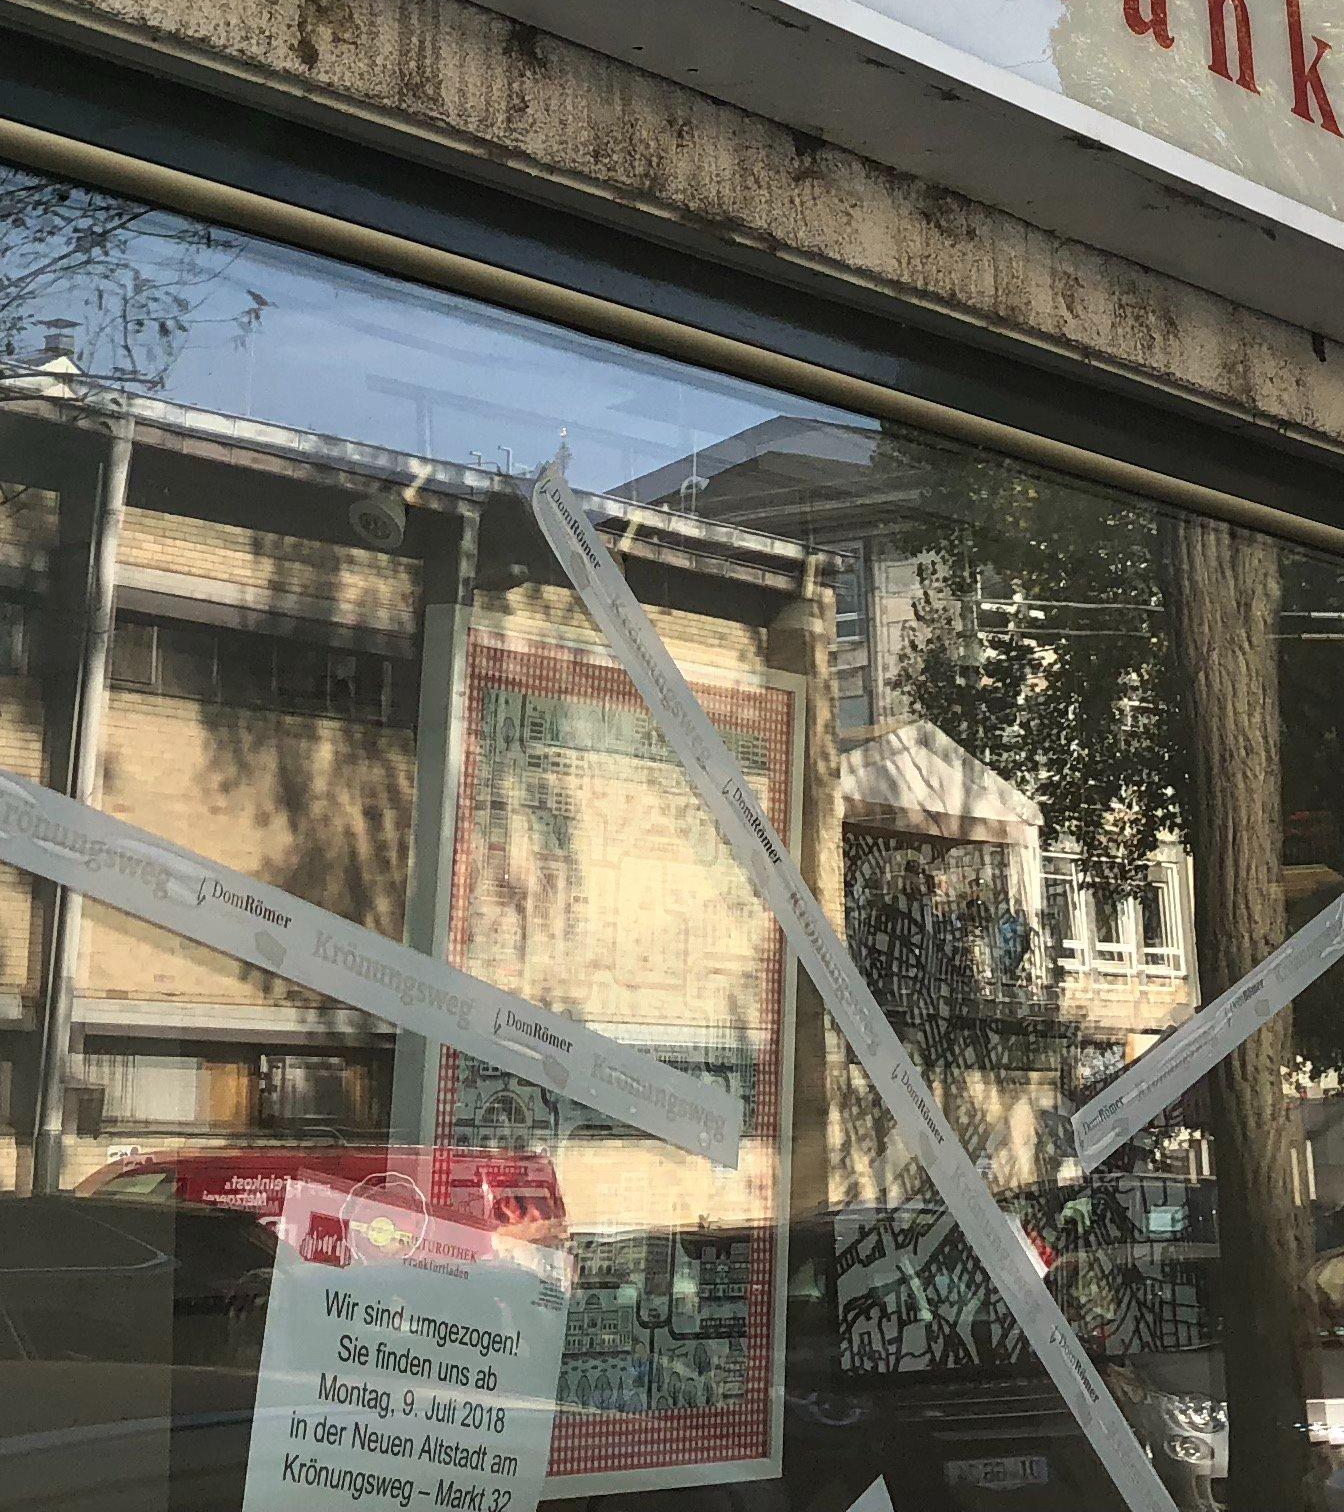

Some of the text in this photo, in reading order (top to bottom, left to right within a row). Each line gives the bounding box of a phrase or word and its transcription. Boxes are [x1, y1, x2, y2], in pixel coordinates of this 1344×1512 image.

[549, 486, 602, 570] DomRömer
[731, 785, 783, 866] DomRömer
[900, 1071, 946, 1146] DomRömer
[211, 879, 293, 930] DomRömer
[312, 929, 476, 1031] Krönungsweg
[505, 1008, 574, 1054] DomRömer
[325, 1288, 521, 1357] Wir sind umgezogen!
[337, 1334, 498, 1392] Sie finden uns ab
[317, 1372, 506, 1434] Montag, 9. Juli 2018
[289, 1410, 519, 1477] in der Neuen Altstadt am
[282, 1452, 415, 1508] Krönungsweg
[434, 1478, 486, 1512] Markt
[487, 1488, 513, 1512] 32
